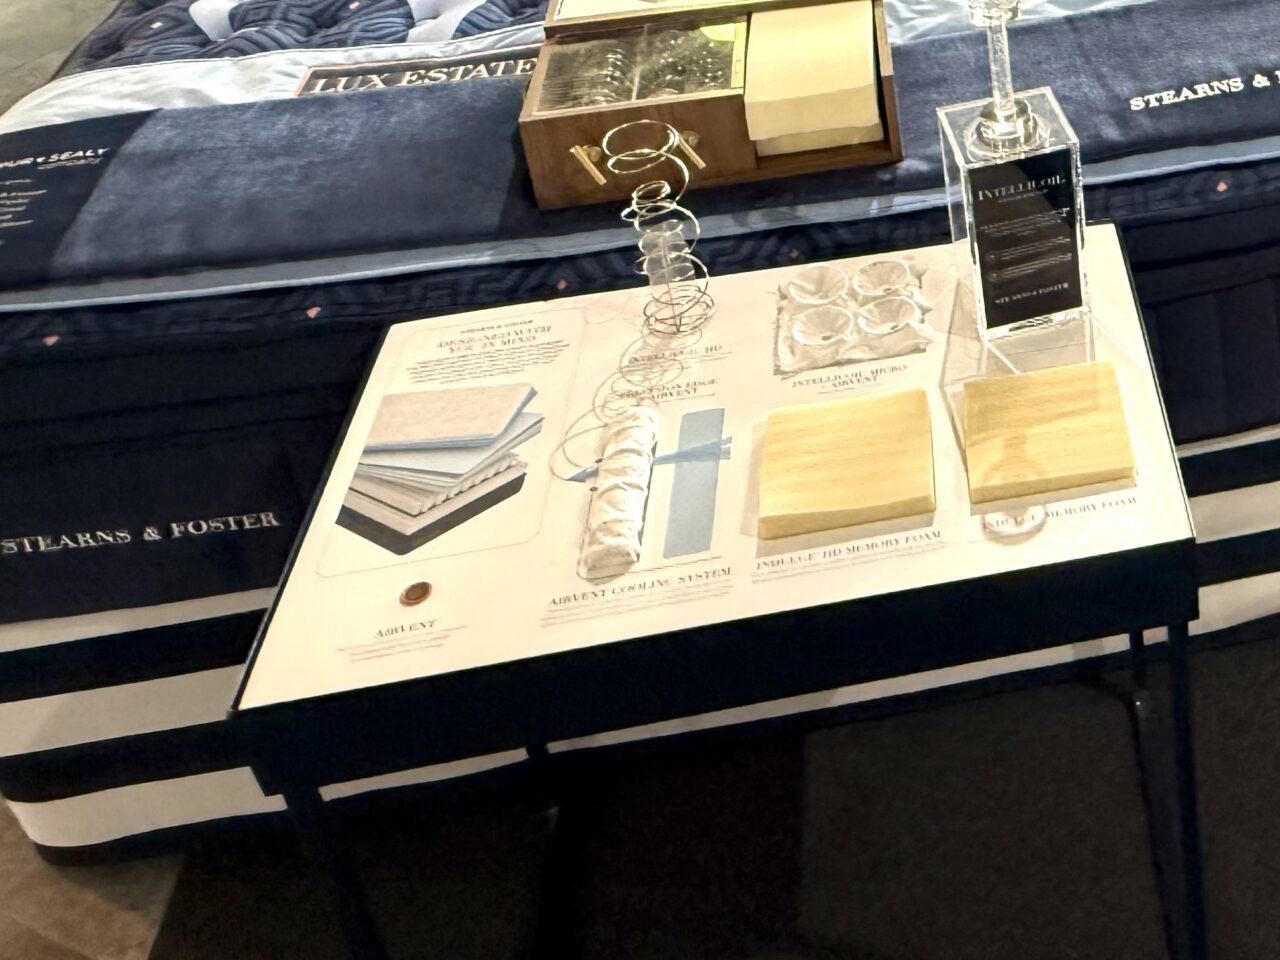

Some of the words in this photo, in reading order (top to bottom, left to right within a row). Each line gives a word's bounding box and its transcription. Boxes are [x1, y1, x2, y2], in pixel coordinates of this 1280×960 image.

[398, 58, 539, 87] ESTATE
[1130, 77, 1244, 111] STEARNS
[1252, 73, 1271, 88] &
[0, 529, 131, 553] STEARNS
[143, 526, 163, 541] &
[169, 512, 281, 538] FOSTER
